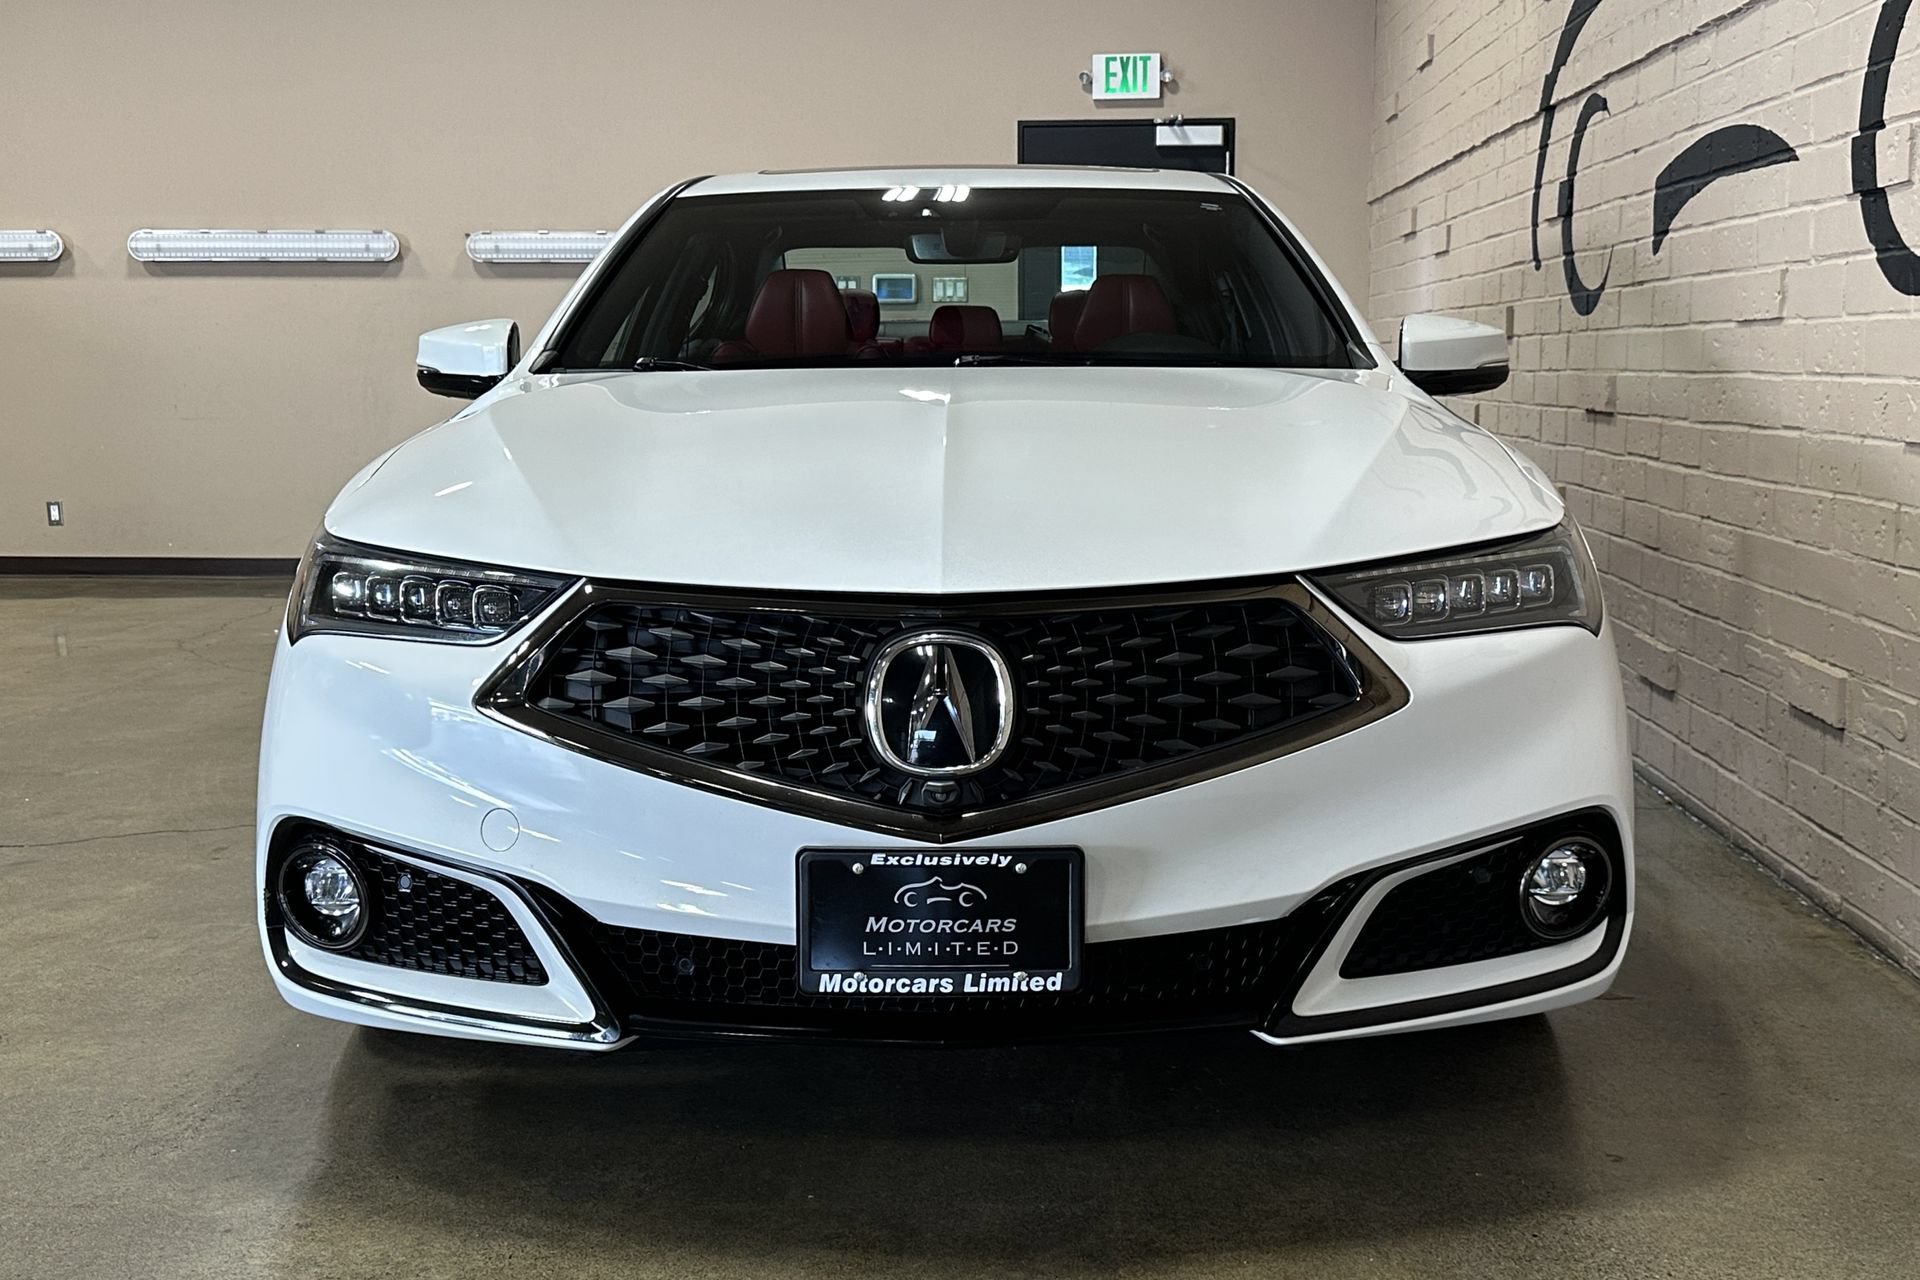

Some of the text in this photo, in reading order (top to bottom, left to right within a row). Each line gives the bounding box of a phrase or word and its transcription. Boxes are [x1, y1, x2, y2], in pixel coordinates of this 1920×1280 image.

[1105, 56, 1151, 93] EXIT
[870, 853, 1013, 867] Exclusively
[865, 916, 1017, 933] MOTORCARS
[818, 972, 1063, 993] Motorcars Limited
